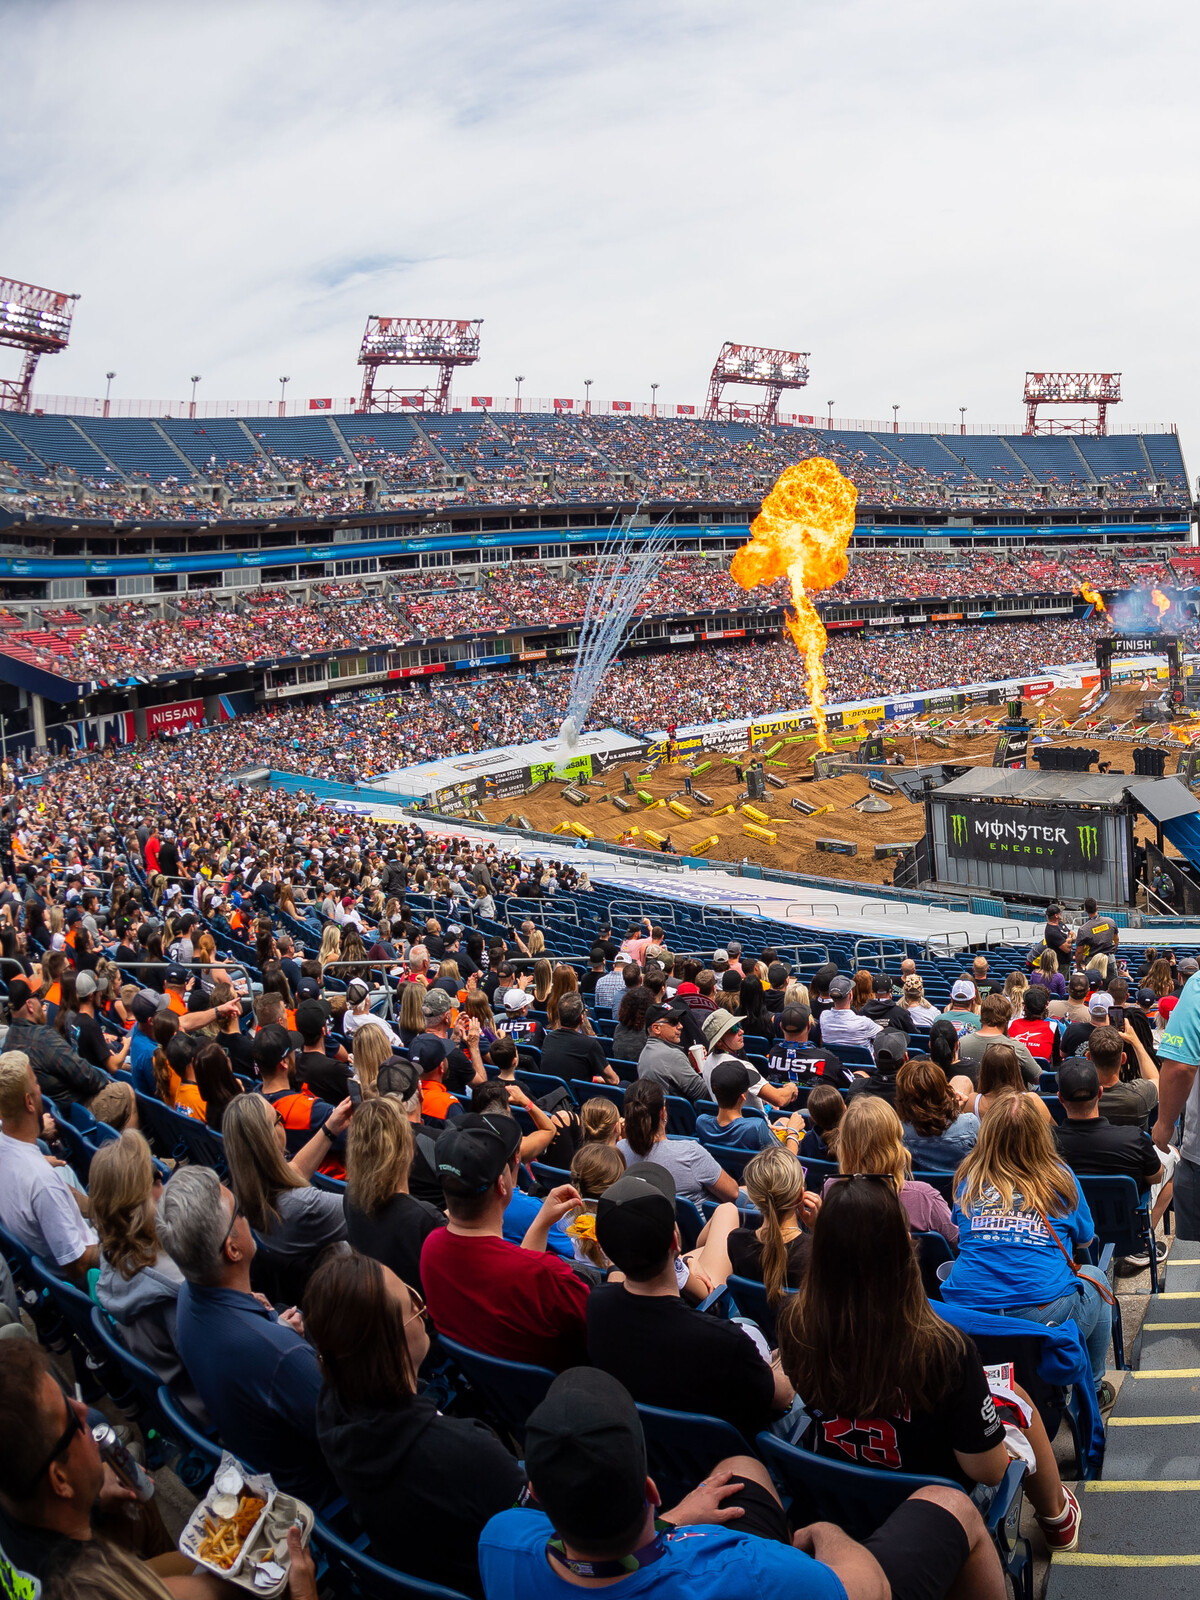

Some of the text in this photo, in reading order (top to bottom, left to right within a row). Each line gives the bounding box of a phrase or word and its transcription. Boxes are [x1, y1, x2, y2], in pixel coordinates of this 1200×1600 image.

[1116, 640, 1152, 650] FINISH
[152, 706, 197, 724] NISSAN
[851, 708, 882, 718] DUNLOP
[753, 720, 798, 736] SUZUKI
[496, 774, 523, 784] COMMISSION
[975, 819, 1069, 844] MONSTER
[990, 842, 1054, 855] ENERGY
[500, 1022, 536, 1032] JUST1
[1163, 1032, 1184, 1046] FXR
[768, 1056, 825, 1076] JUST1
[971, 1215, 1050, 1238] WHIPPLE
[822, 1414, 902, 1469] 23
